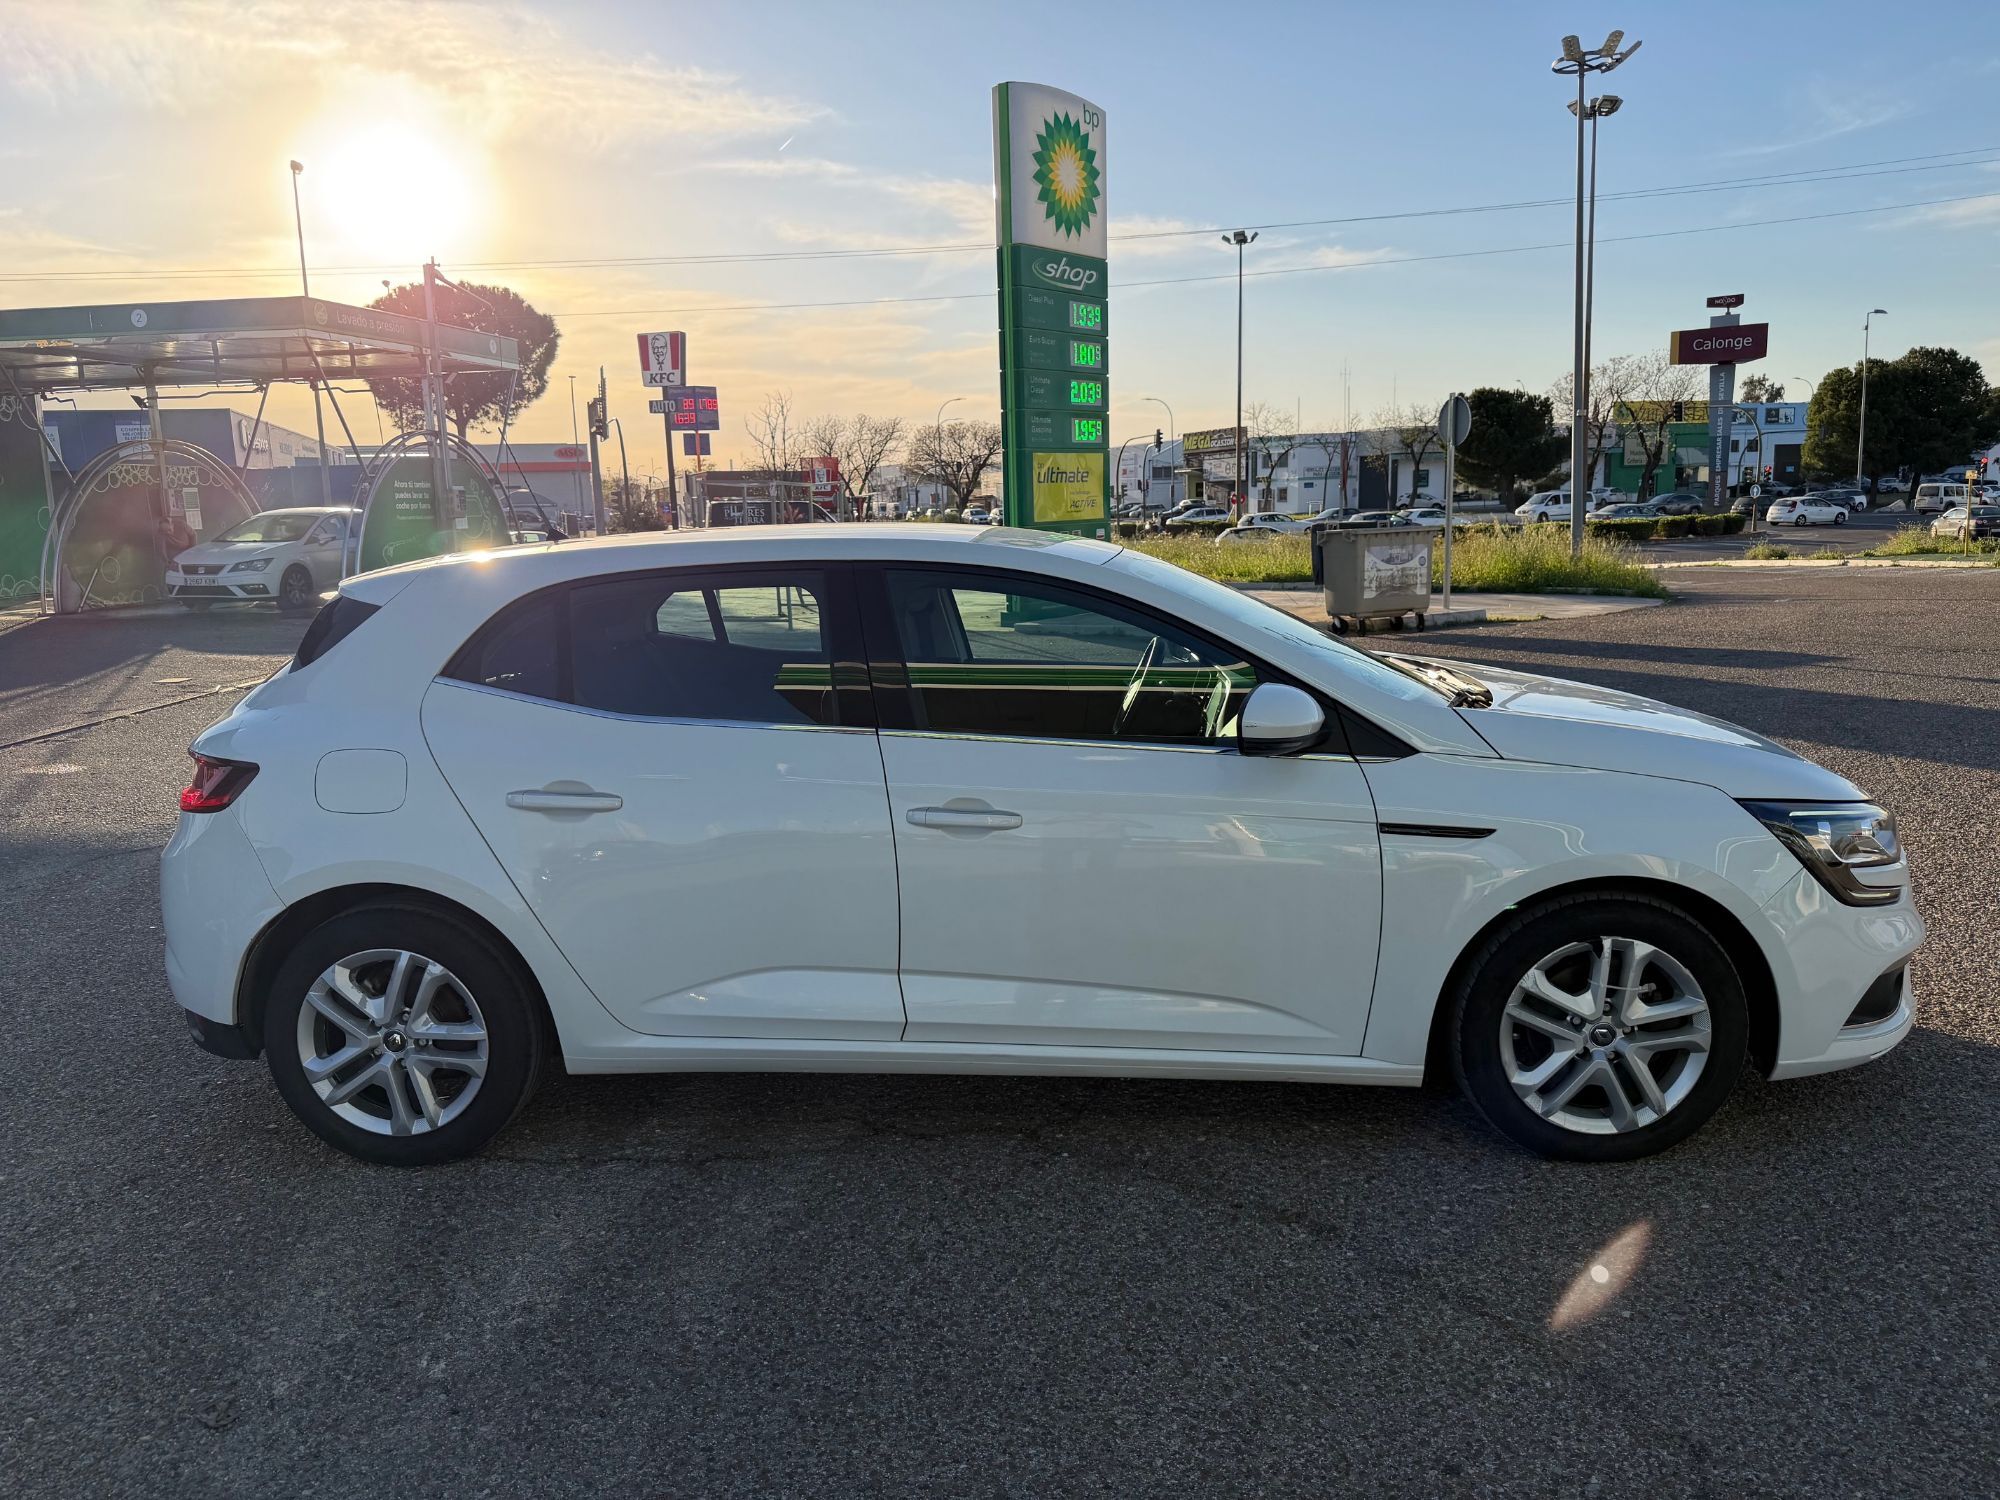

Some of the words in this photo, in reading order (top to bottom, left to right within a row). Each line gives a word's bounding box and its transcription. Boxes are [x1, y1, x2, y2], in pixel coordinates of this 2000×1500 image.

[1083, 104, 1100, 131] bp
[1046, 257, 1097, 291] shop
[136, 312, 143, 323] 2
[336, 312, 368, 328] Lavado
[369, 321, 375, 329] a
[1692, 336, 1753, 351] Calonge
[648, 372, 676, 385] KFC
[1718, 371, 1727, 401] SEVILLA
[652, 400, 676, 413] AUTO
[1183, 434, 1212, 451] MEGA
[1715, 416, 1724, 472] EMPRESARIALES
[1037, 466, 1089, 484] ultimate
[393, 480, 408, 488] Ahora
[1713, 474, 1721, 507] PARQUES
[395, 501, 410, 510] coche
